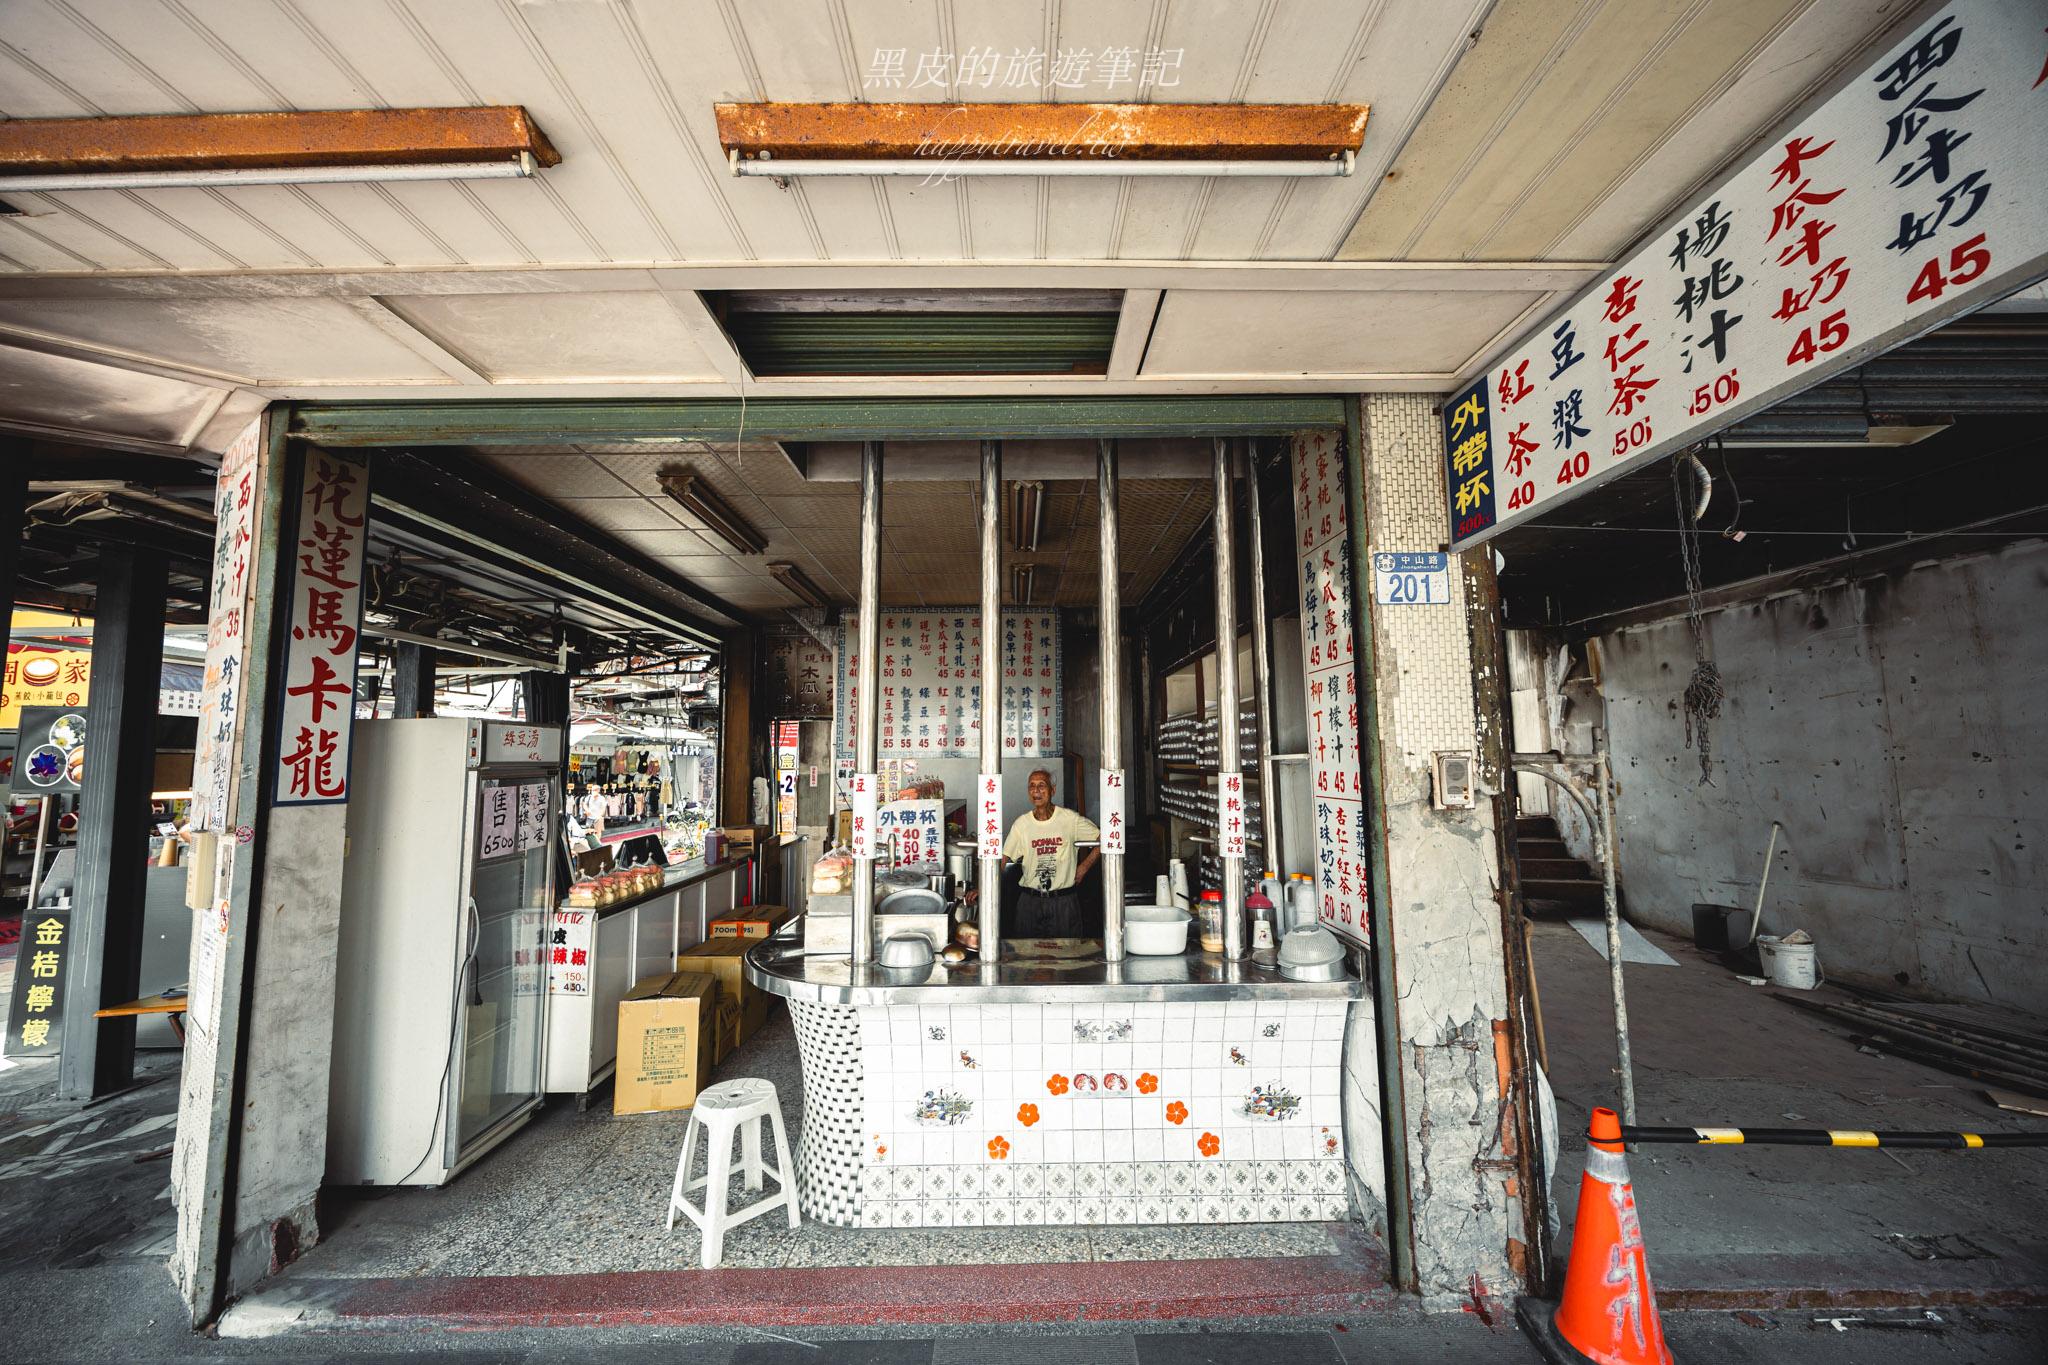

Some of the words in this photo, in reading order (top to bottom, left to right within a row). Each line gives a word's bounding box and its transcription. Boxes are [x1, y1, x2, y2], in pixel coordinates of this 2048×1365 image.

[1873, 15, 1992, 256] 西瓜牛奶
[1766, 136, 1852, 325] 木瓜牛奶
[1906, 232, 1992, 306] 45
[1668, 200, 1744, 374] 楊桃汁
[1600, 275, 1660, 416] 杏仁茶
[1786, 308, 1850, 367] 45
[1548, 319, 1592, 450] 豆漿
[1498, 359, 1541, 478] 紅茶
[1451, 393, 1490, 516] 外帶杯
[1557, 451, 1590, 485] 40
[1507, 480, 1535, 510] 40
[231, 471, 251, 598] 西瓜汁
[1303, 526, 1313, 549] 45
[1320, 513, 1331, 537] 45
[1401, 555, 1438, 565] 中山路
[1389, 573, 1431, 603] 201
[226, 607, 240, 638] 35
[281, 459, 365, 799] 花蓮馬卡龍
[1310, 645, 1320, 667] 45
[1327, 639, 1338, 662] 45
[64, 659, 89, 685] 家
[884, 668, 894, 677] 50
[901, 668, 912, 677] 50
[938, 669, 949, 678] 45
[954, 669, 965, 678] 45
[1005, 668, 1016, 677] 50
[1022, 668, 1033, 677] 45
[1310, 679, 1326, 764] 柳丁汁
[1328, 674, 1343, 764] 檸檬汁
[503, 729, 540, 748] 綠豆湯
[883, 739, 894, 748] 55
[900, 739, 911, 748] 55
[919, 739, 929, 748] 45
[937, 737, 948, 747] 45
[954, 738, 965, 747] 55
[1317, 770, 1328, 792] 45
[1334, 770, 1345, 793] 45
[855, 778, 865, 831] 豆漿
[985, 778, 998, 835] 杏仁茶
[1107, 774, 1121, 827] 紅茶
[1227, 776, 1241, 833] 楊桃汁
[880, 809, 937, 826] 外帶杯
[484, 834, 514, 855] 6500
[854, 836, 864, 845] 40
[902, 828, 920, 840] 40
[1109, 831, 1120, 840] 40
[1318, 802, 1335, 889] 珍珠奶茶
[903, 841, 919, 854] 50
[1335, 807, 1352, 895] 杏仁+紅茶
[1324, 893, 1334, 920] 60
[1340, 902, 1352, 924] 50
[21, 917, 65, 1047] 金桔檸檬
